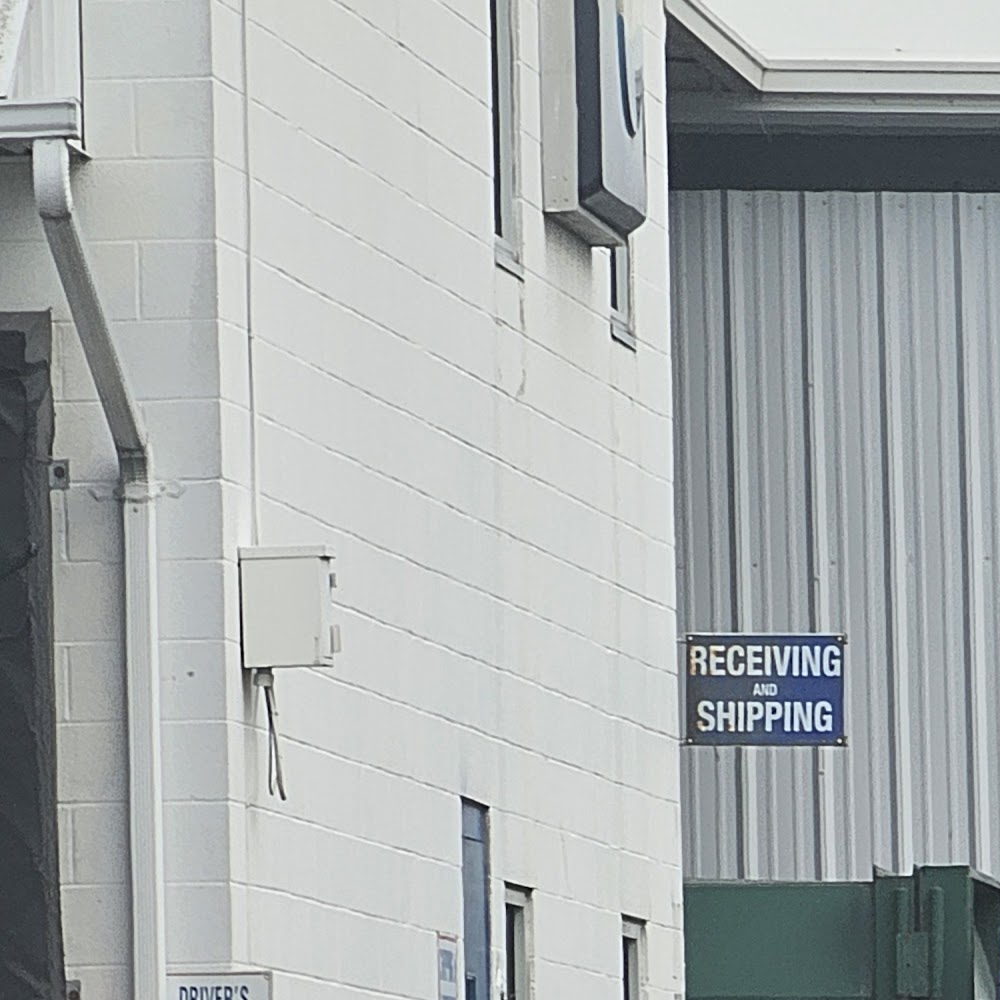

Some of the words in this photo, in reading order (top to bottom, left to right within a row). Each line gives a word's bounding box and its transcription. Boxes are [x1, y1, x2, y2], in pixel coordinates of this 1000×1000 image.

[689, 644, 841, 677] RECEIVING
[752, 683, 779, 697] AND
[696, 701, 833, 732] SHIPPING
